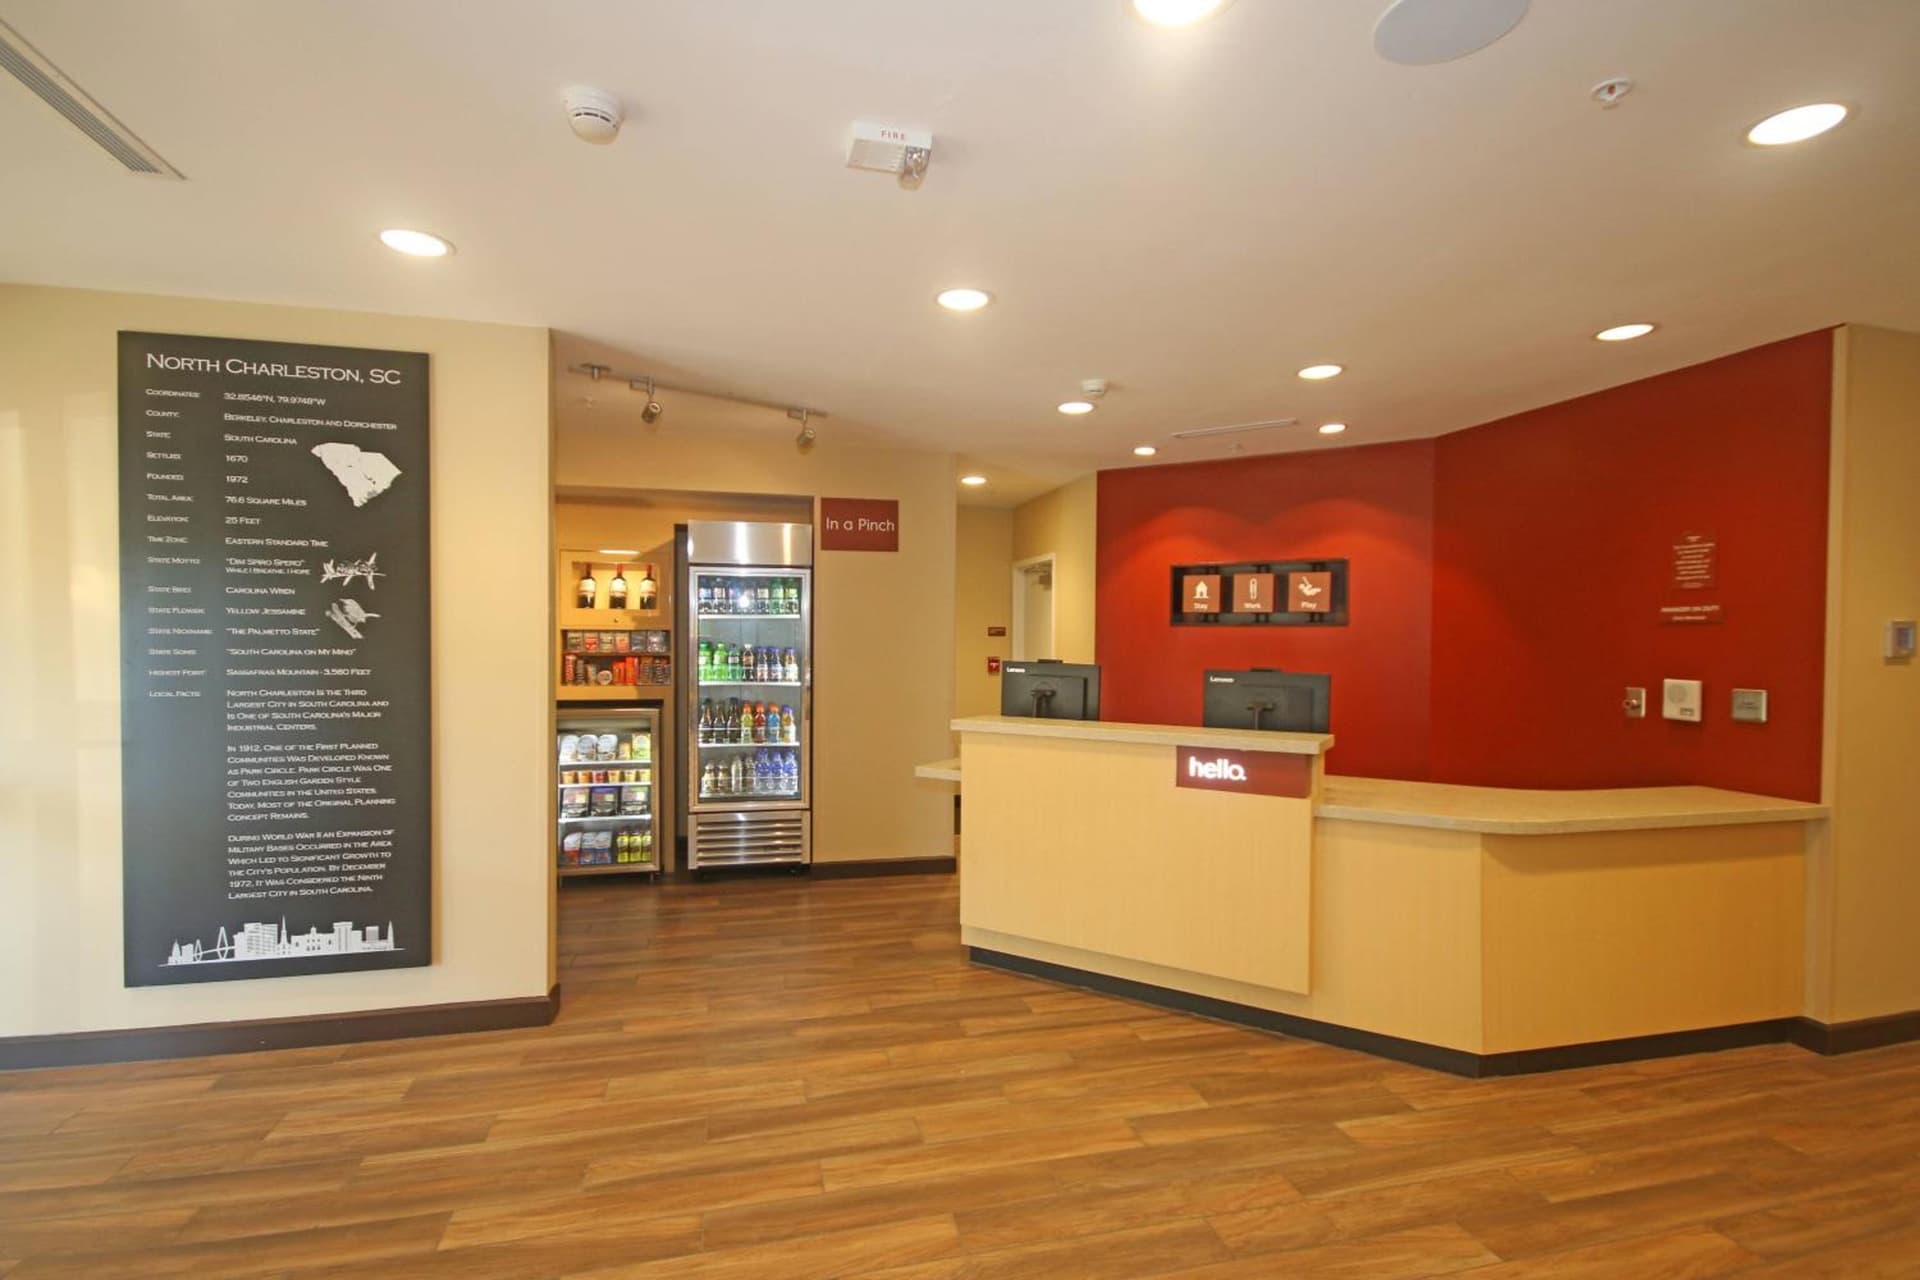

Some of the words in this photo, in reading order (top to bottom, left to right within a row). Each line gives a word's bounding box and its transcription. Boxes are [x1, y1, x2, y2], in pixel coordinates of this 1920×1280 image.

[881, 130, 904, 140] FIRE
[826, 517, 839, 531] In
[843, 520, 853, 531] a
[858, 518, 895, 532] Pinch
[1193, 602, 1208, 611] Stay
[1301, 601, 1317, 610] Play
